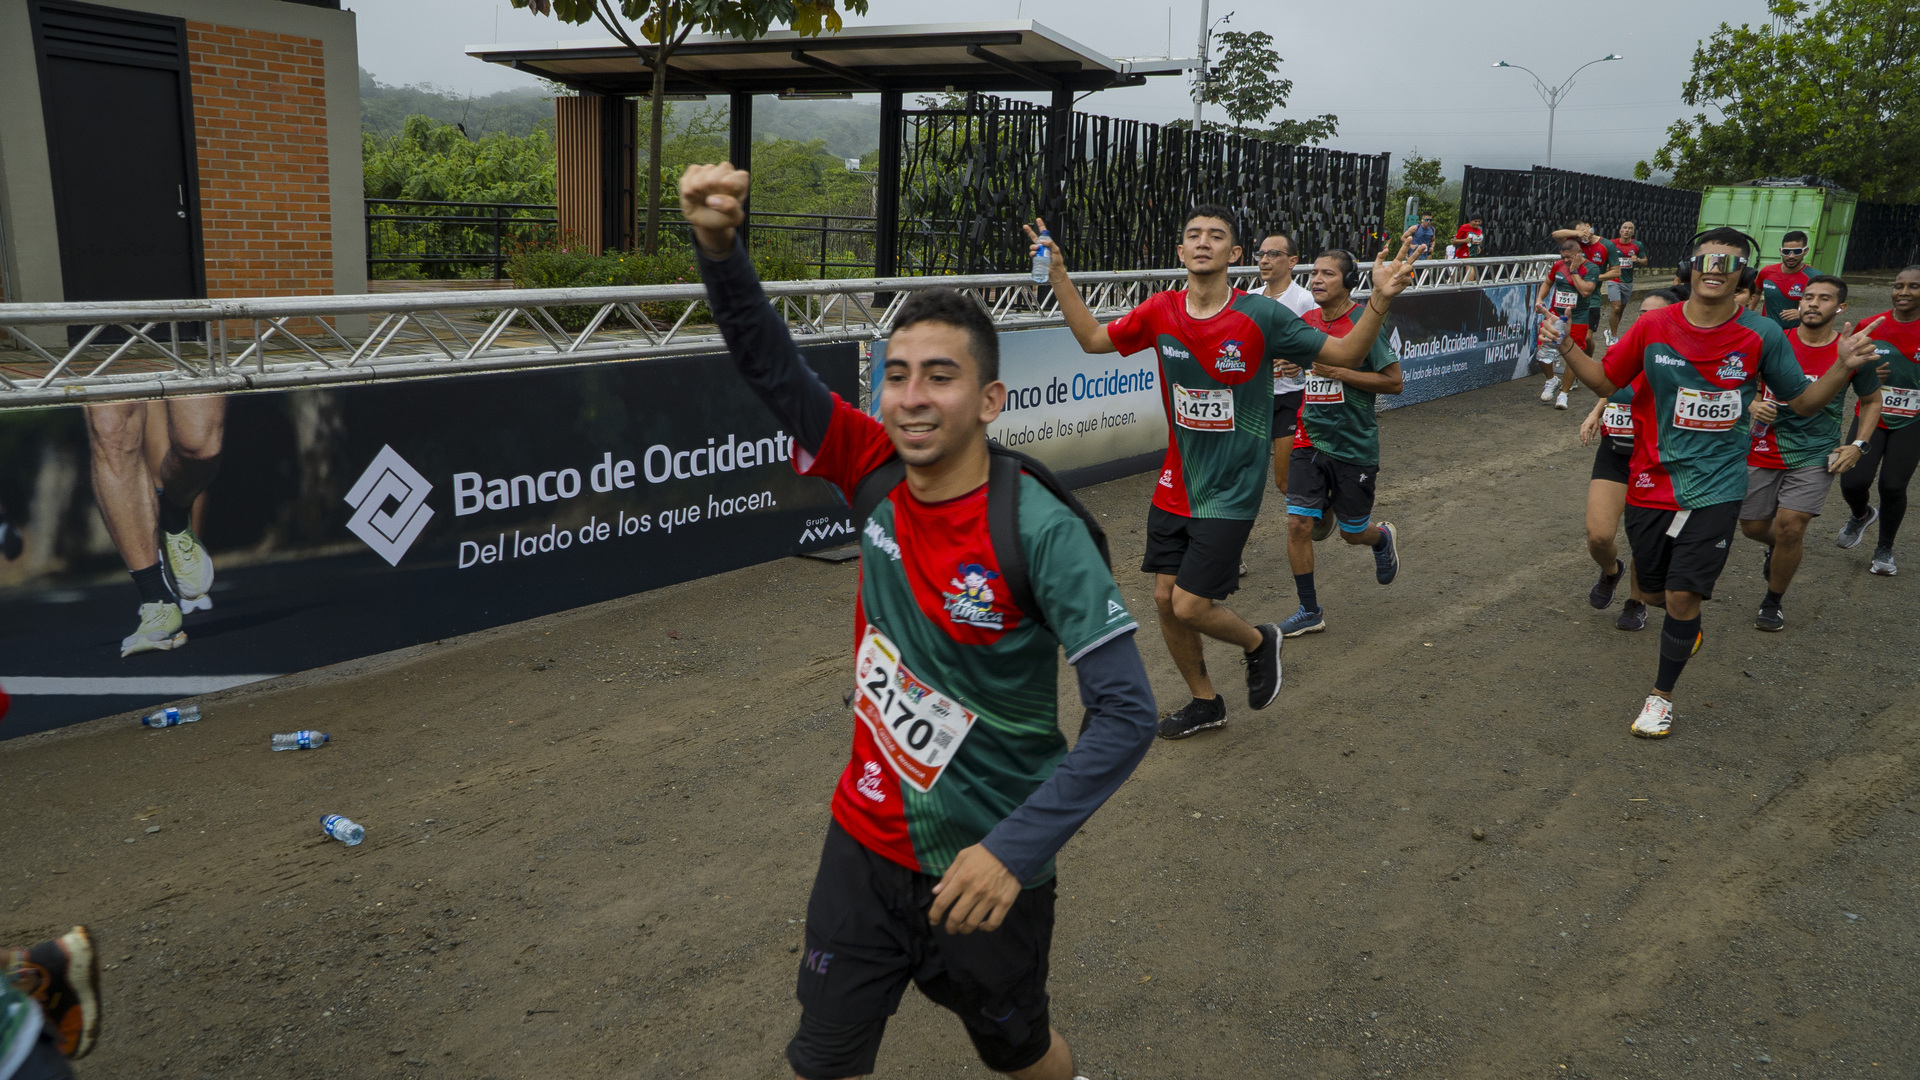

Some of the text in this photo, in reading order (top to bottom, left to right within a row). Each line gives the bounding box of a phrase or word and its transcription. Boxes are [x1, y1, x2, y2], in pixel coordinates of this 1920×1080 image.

[1403, 333, 1478, 360] Banco de Occidente
[1486, 326, 1496, 343] TU
[1412, 367, 1425, 381] lado
[1425, 365, 1432, 378] de
[1433, 364, 1441, 376] los
[1441, 365, 1451, 377] que
[1046, 377, 1067, 405] de
[1072, 368, 1154, 401] Occidente
[1306, 381, 1333, 392] 1877
[1182, 401, 1222, 417] 1473
[1687, 402, 1731, 418] 1665
[1885, 396, 1910, 408] 681
[1006, 425, 1035, 447] lado
[1037, 421, 1053, 441] de
[1056, 419, 1073, 437] los
[1077, 418, 1098, 438] que
[1101, 412, 1137, 430] hacen.
[453, 467, 582, 517] Banco
[590, 452, 636, 493] de
[458, 490, 777, 569] Del lado de los que hacen.
[799, 518, 856, 544] AVAL
[806, 516, 829, 528] Grupo
[866, 666, 934, 751] 2170
[803, 949, 834, 975] KE
